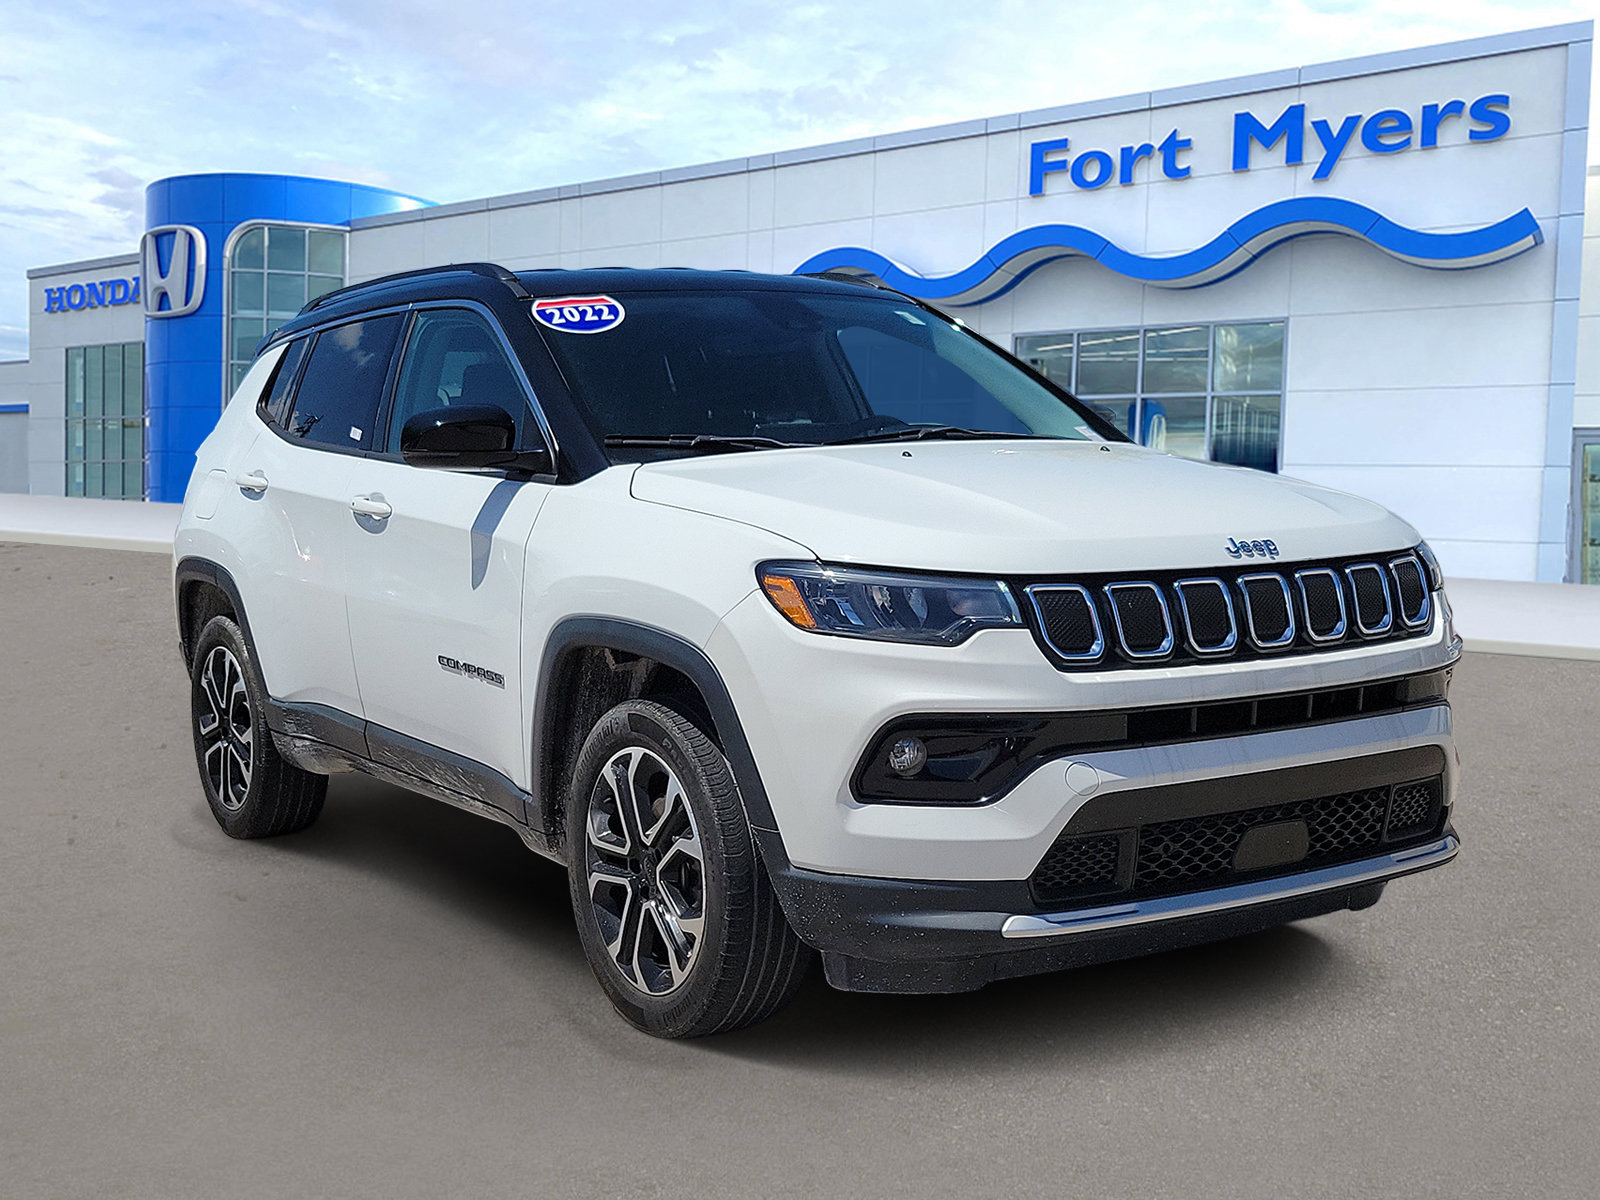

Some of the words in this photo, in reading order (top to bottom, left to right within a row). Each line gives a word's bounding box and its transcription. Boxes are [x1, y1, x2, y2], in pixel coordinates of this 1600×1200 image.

[1029, 129, 1191, 195] Fort
[1232, 95, 1510, 179] Myers
[545, 305, 615, 325] 2022
[1224, 536, 1279, 558] Jeep
[437, 654, 505, 687] COMPASS
